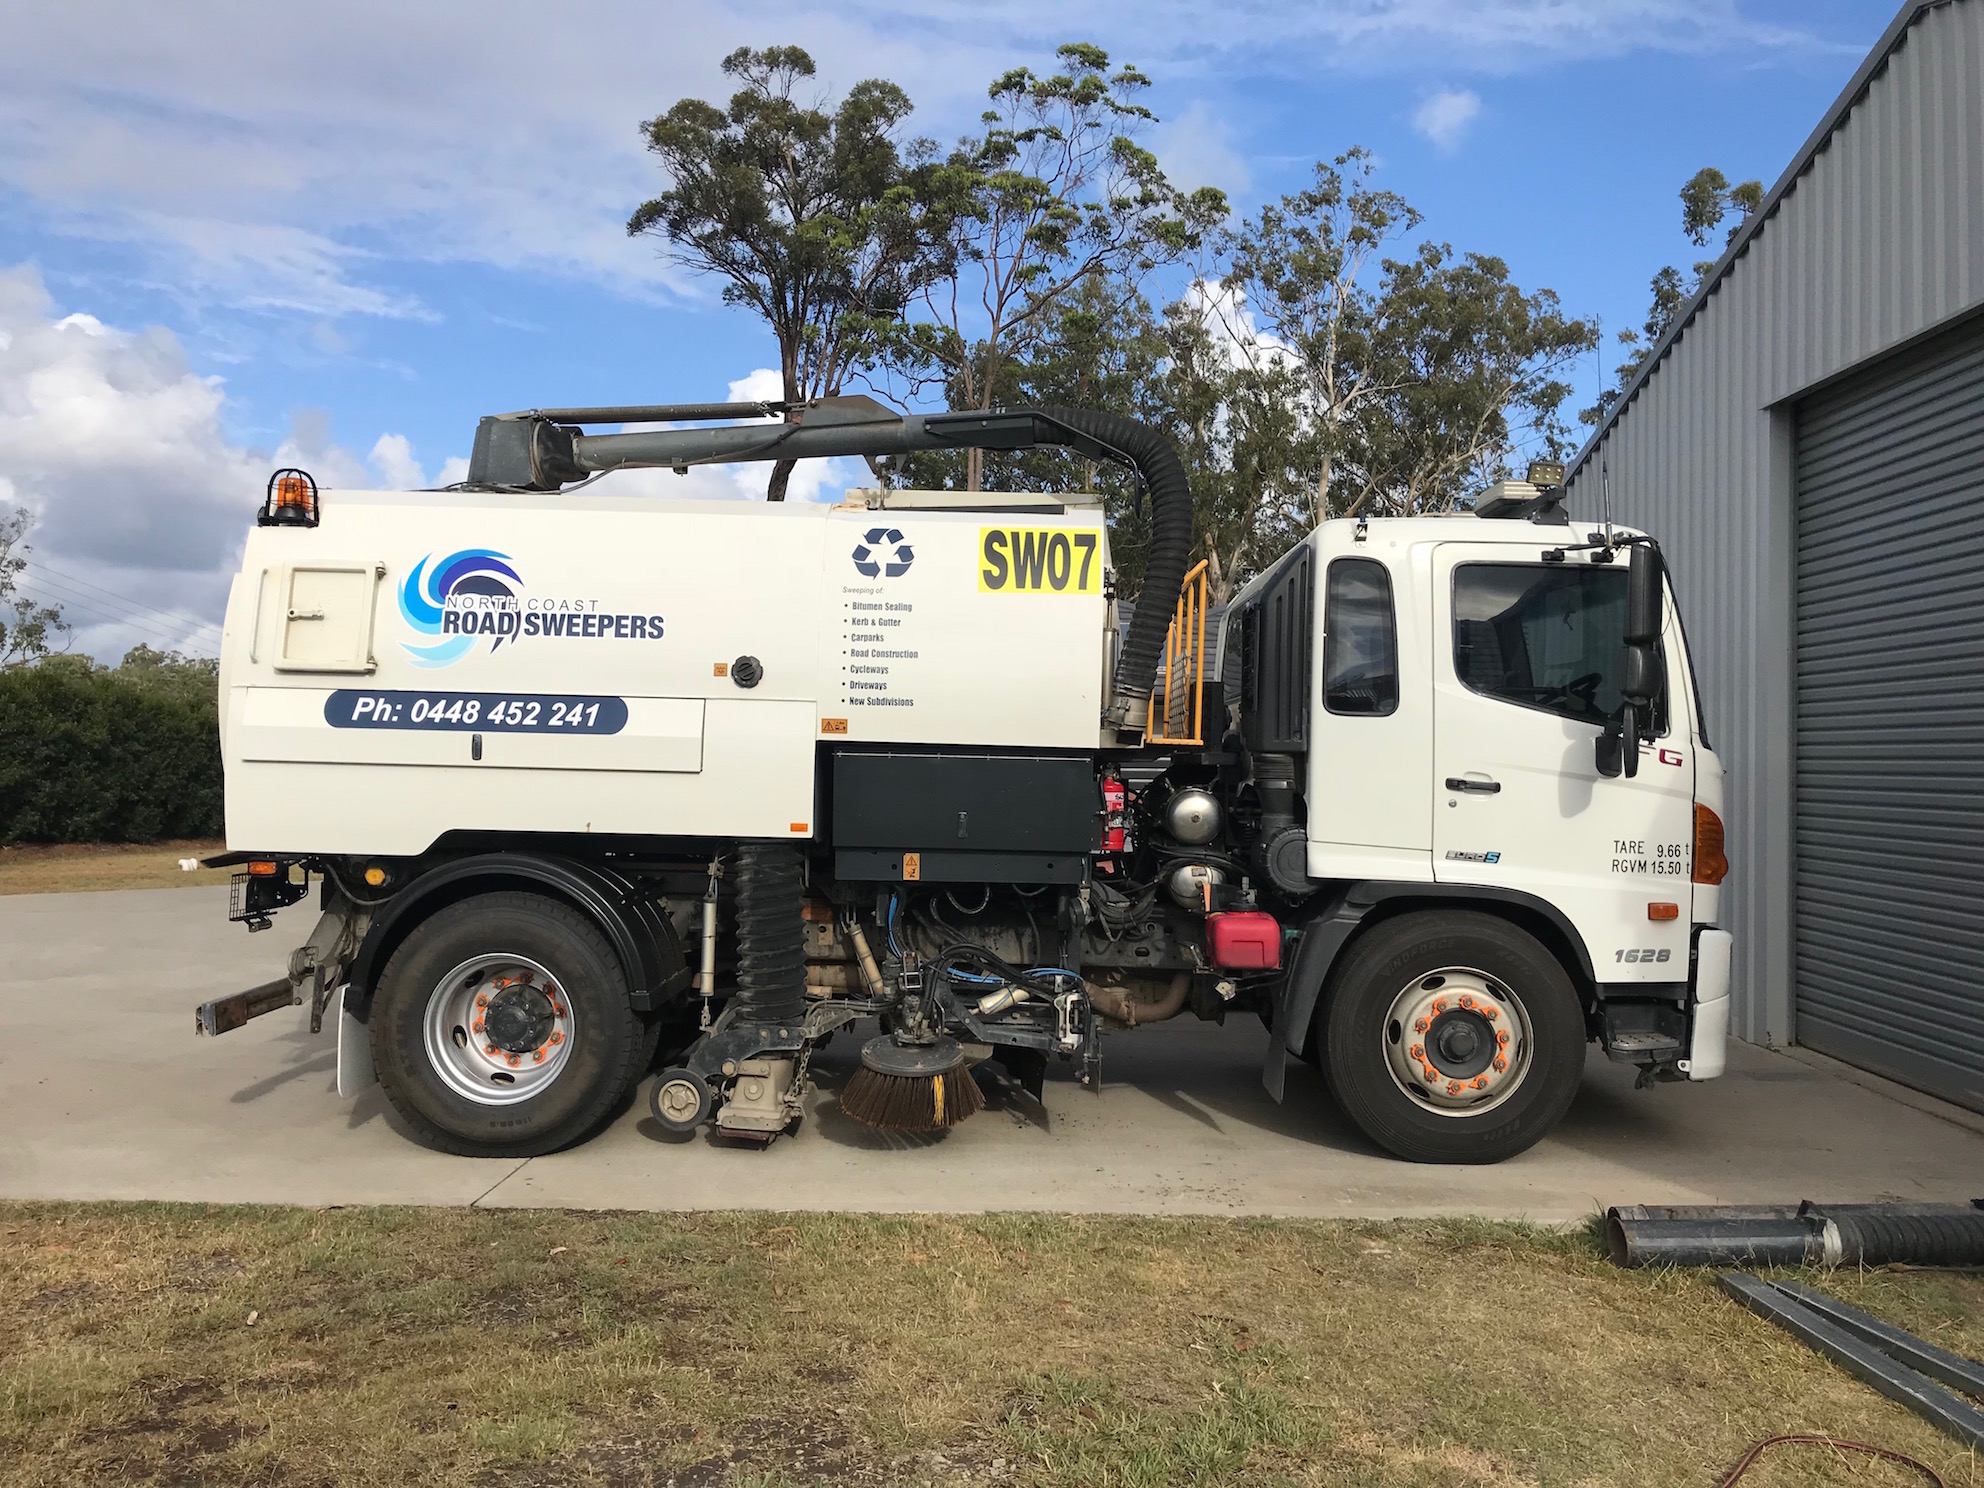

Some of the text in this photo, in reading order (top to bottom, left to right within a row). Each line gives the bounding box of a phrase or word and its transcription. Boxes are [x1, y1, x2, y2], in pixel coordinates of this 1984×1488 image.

[982, 530, 1097, 590] SW07
[842, 586, 884, 595] Sweeping of:
[446, 596, 599, 612] NORTH COAST
[852, 601, 913, 612] Bitumen Sealing
[443, 610, 665, 640] ROAD SWEEPERS
[851, 617, 901, 627] Kerb & Gutter
[851, 633, 885, 642] Carparks
[850, 648, 919, 659] Road Construction
[850, 664, 889, 674] Cycleways
[849, 680, 887, 690] Driveways
[849, 696, 914, 707] New Subdivisions
[351, 697, 601, 727] Ph: 0448 452 241
[1613, 840, 1645, 854] TARE
[1657, 844, 1681, 858] 9.66
[1612, 859, 1647, 873] RGVM
[1651, 861, 1681, 875] 15.50
[1615, 948, 1671, 963] 1628
